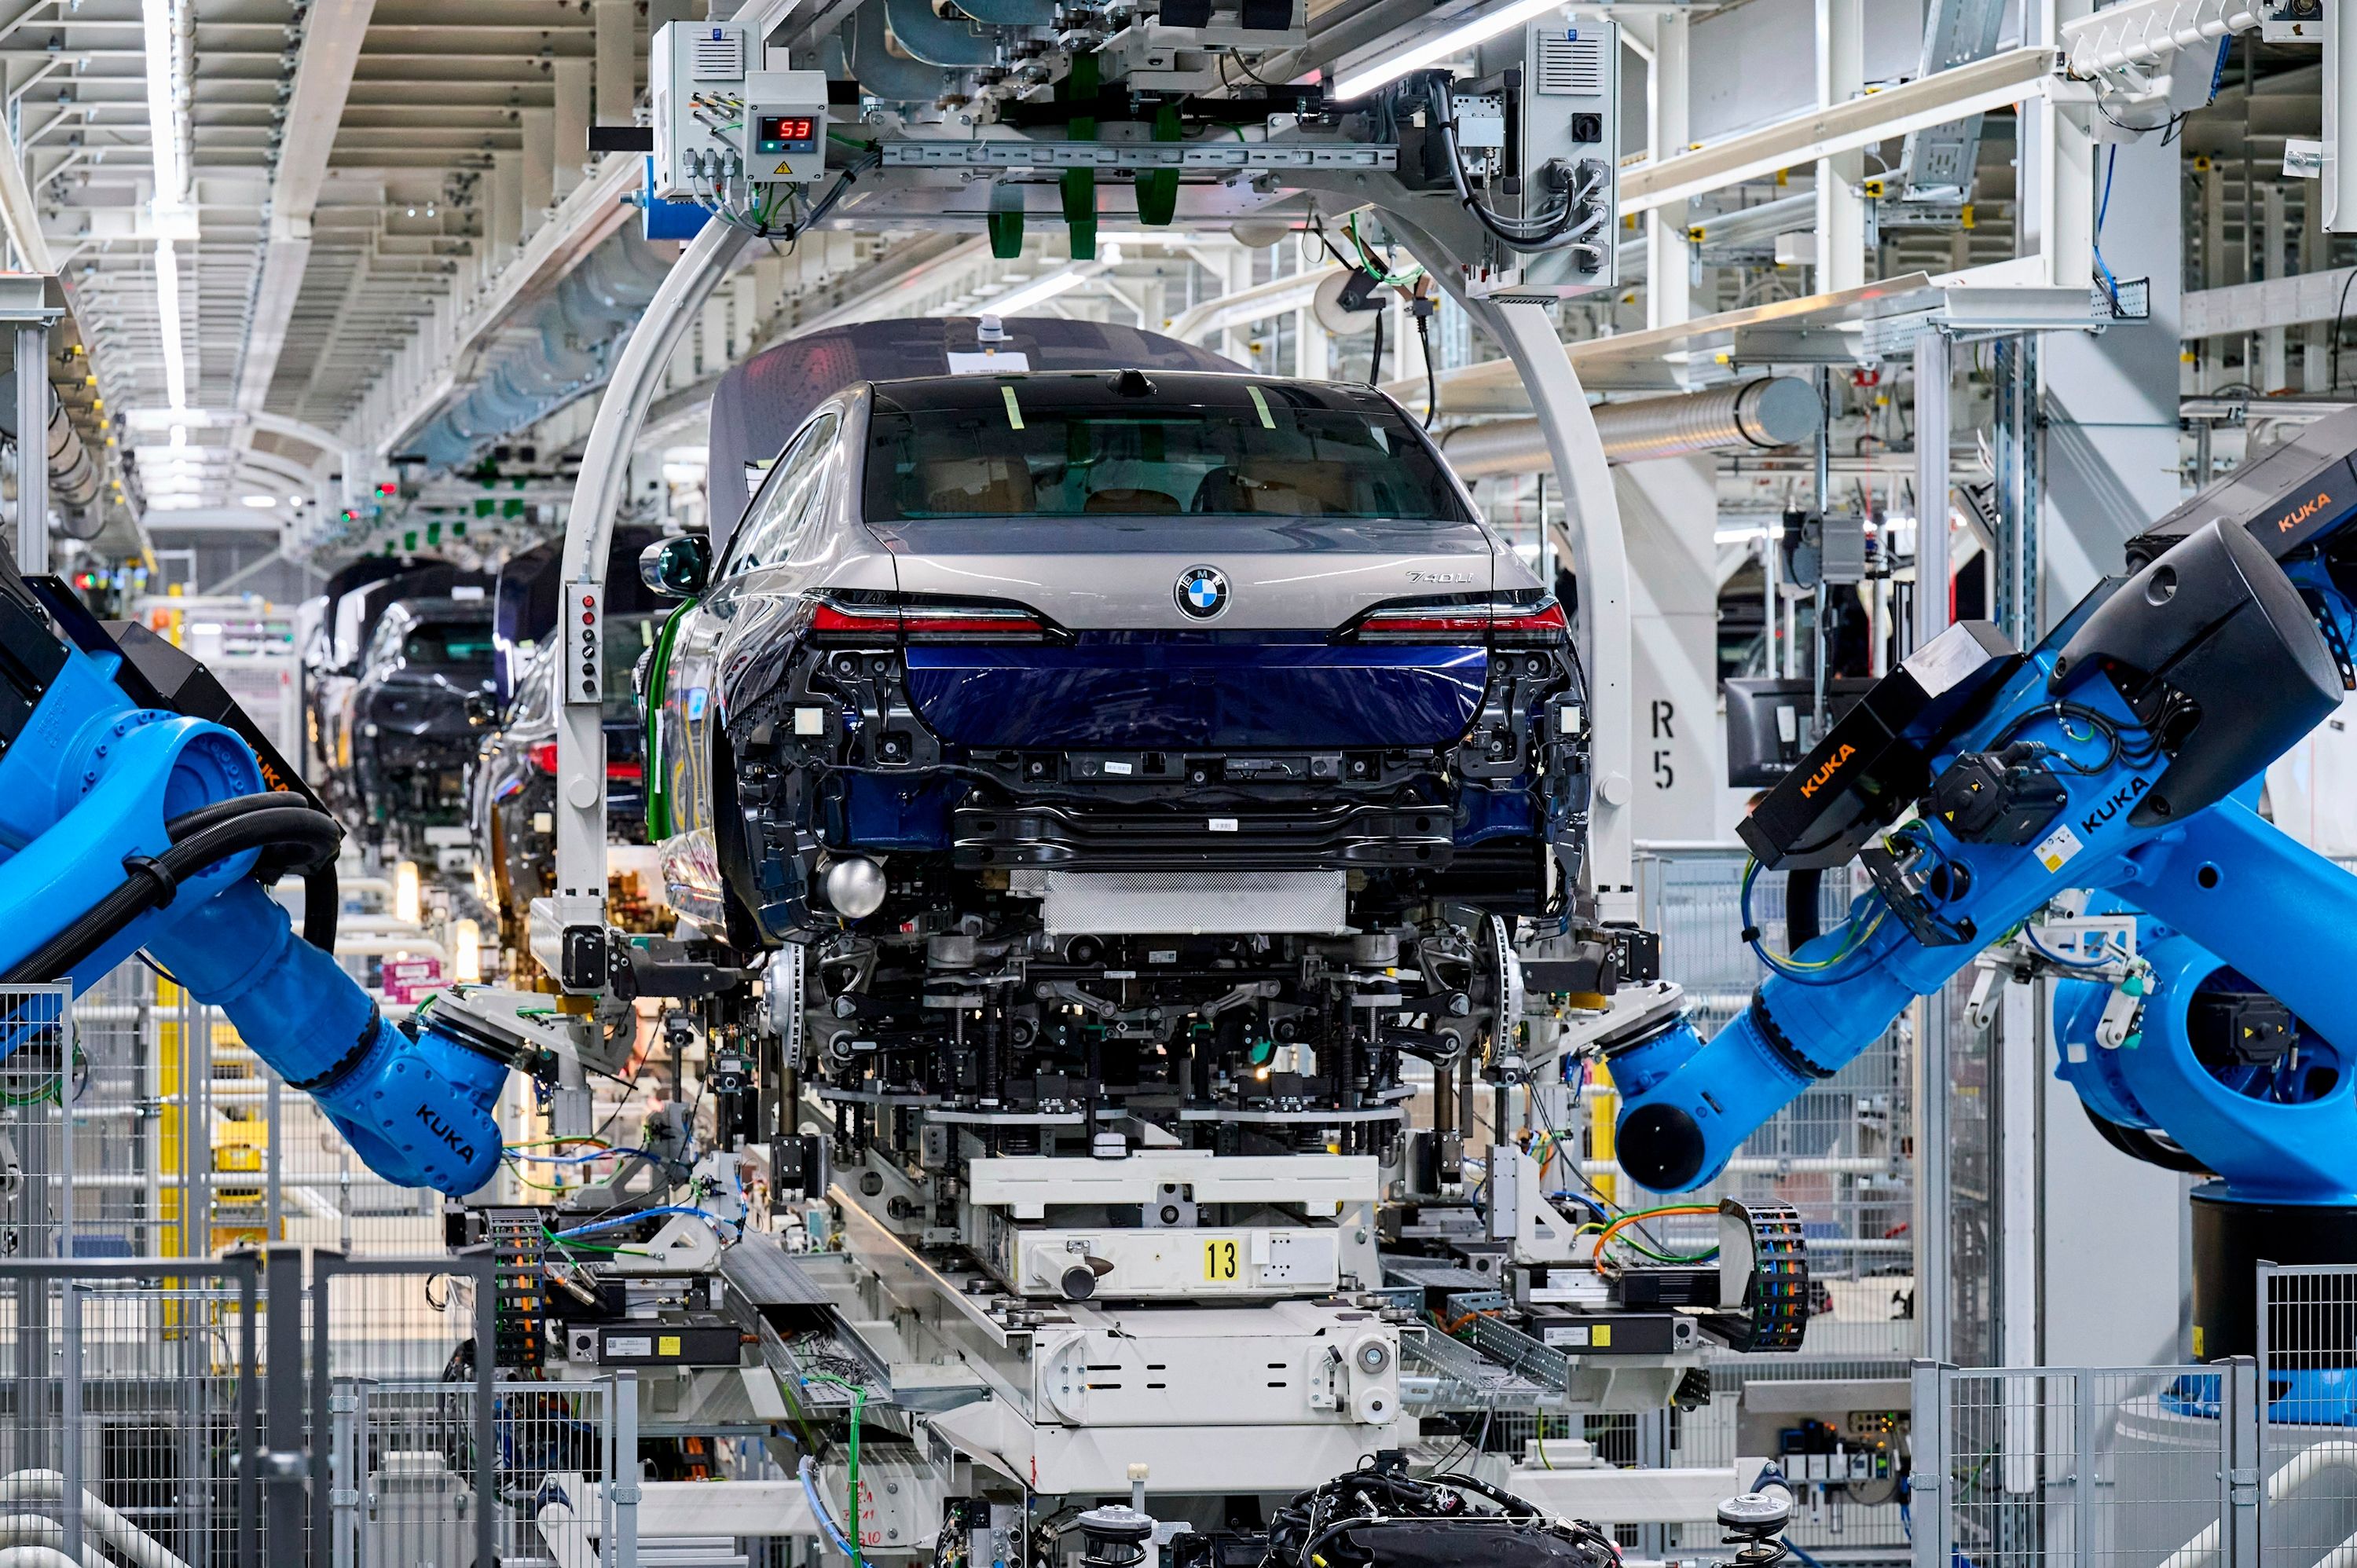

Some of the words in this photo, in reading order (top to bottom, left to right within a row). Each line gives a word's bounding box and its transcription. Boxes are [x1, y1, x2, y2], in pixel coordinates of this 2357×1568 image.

[780, 121, 809, 137] 53
[2278, 493, 2332, 533] KUKA
[1180, 570, 1223, 588] BMW
[1652, 700, 1673, 738] R
[1654, 750, 1673, 789] 5
[1800, 743, 1856, 799] KUKA
[2081, 775, 2150, 835] KUKA
[416, 1103, 475, 1166] KUKA
[1208, 1242, 1236, 1278] 13
